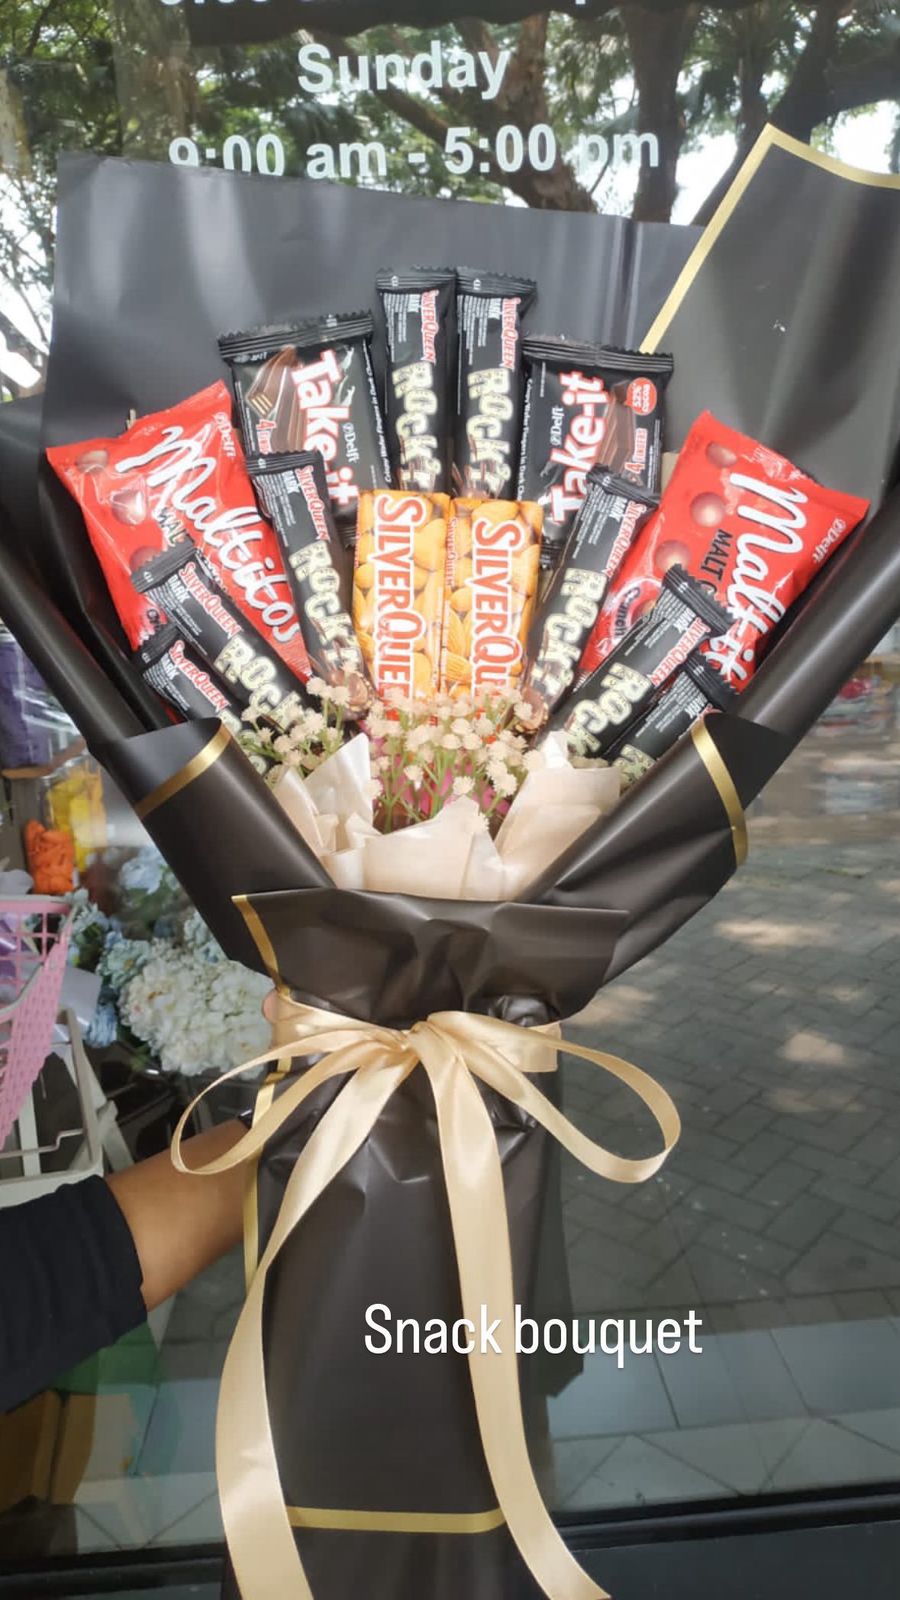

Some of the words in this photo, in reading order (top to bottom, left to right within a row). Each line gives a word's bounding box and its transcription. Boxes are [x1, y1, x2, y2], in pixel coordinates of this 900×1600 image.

[298, 40, 511, 100] Sunday
[305, 141, 388, 179] am
[444, 123, 556, 175] 5:00
[578, 132, 660, 181] pm
[291, 349, 360, 505] Takeit
[550, 370, 608, 523] Take-it
[115, 426, 299, 642] Maltitos
[295, 465, 331, 542] SILVERQUEEN
[600, 500, 647, 579] SILVERQUEEN
[167, 574, 190, 603] DARK
[700, 528, 733, 583] MALT
[703, 473, 808, 681] Maltit
[178, 562, 245, 640] SILVERQUEEN
[464, 520, 524, 697] SILVERQU
[168, 640, 231, 713] SILVERQUEEN
[214, 637, 302, 730] ROCK
[645, 617, 712, 687] SILVERQUEEN
[565, 662, 651, 757] ROCK
